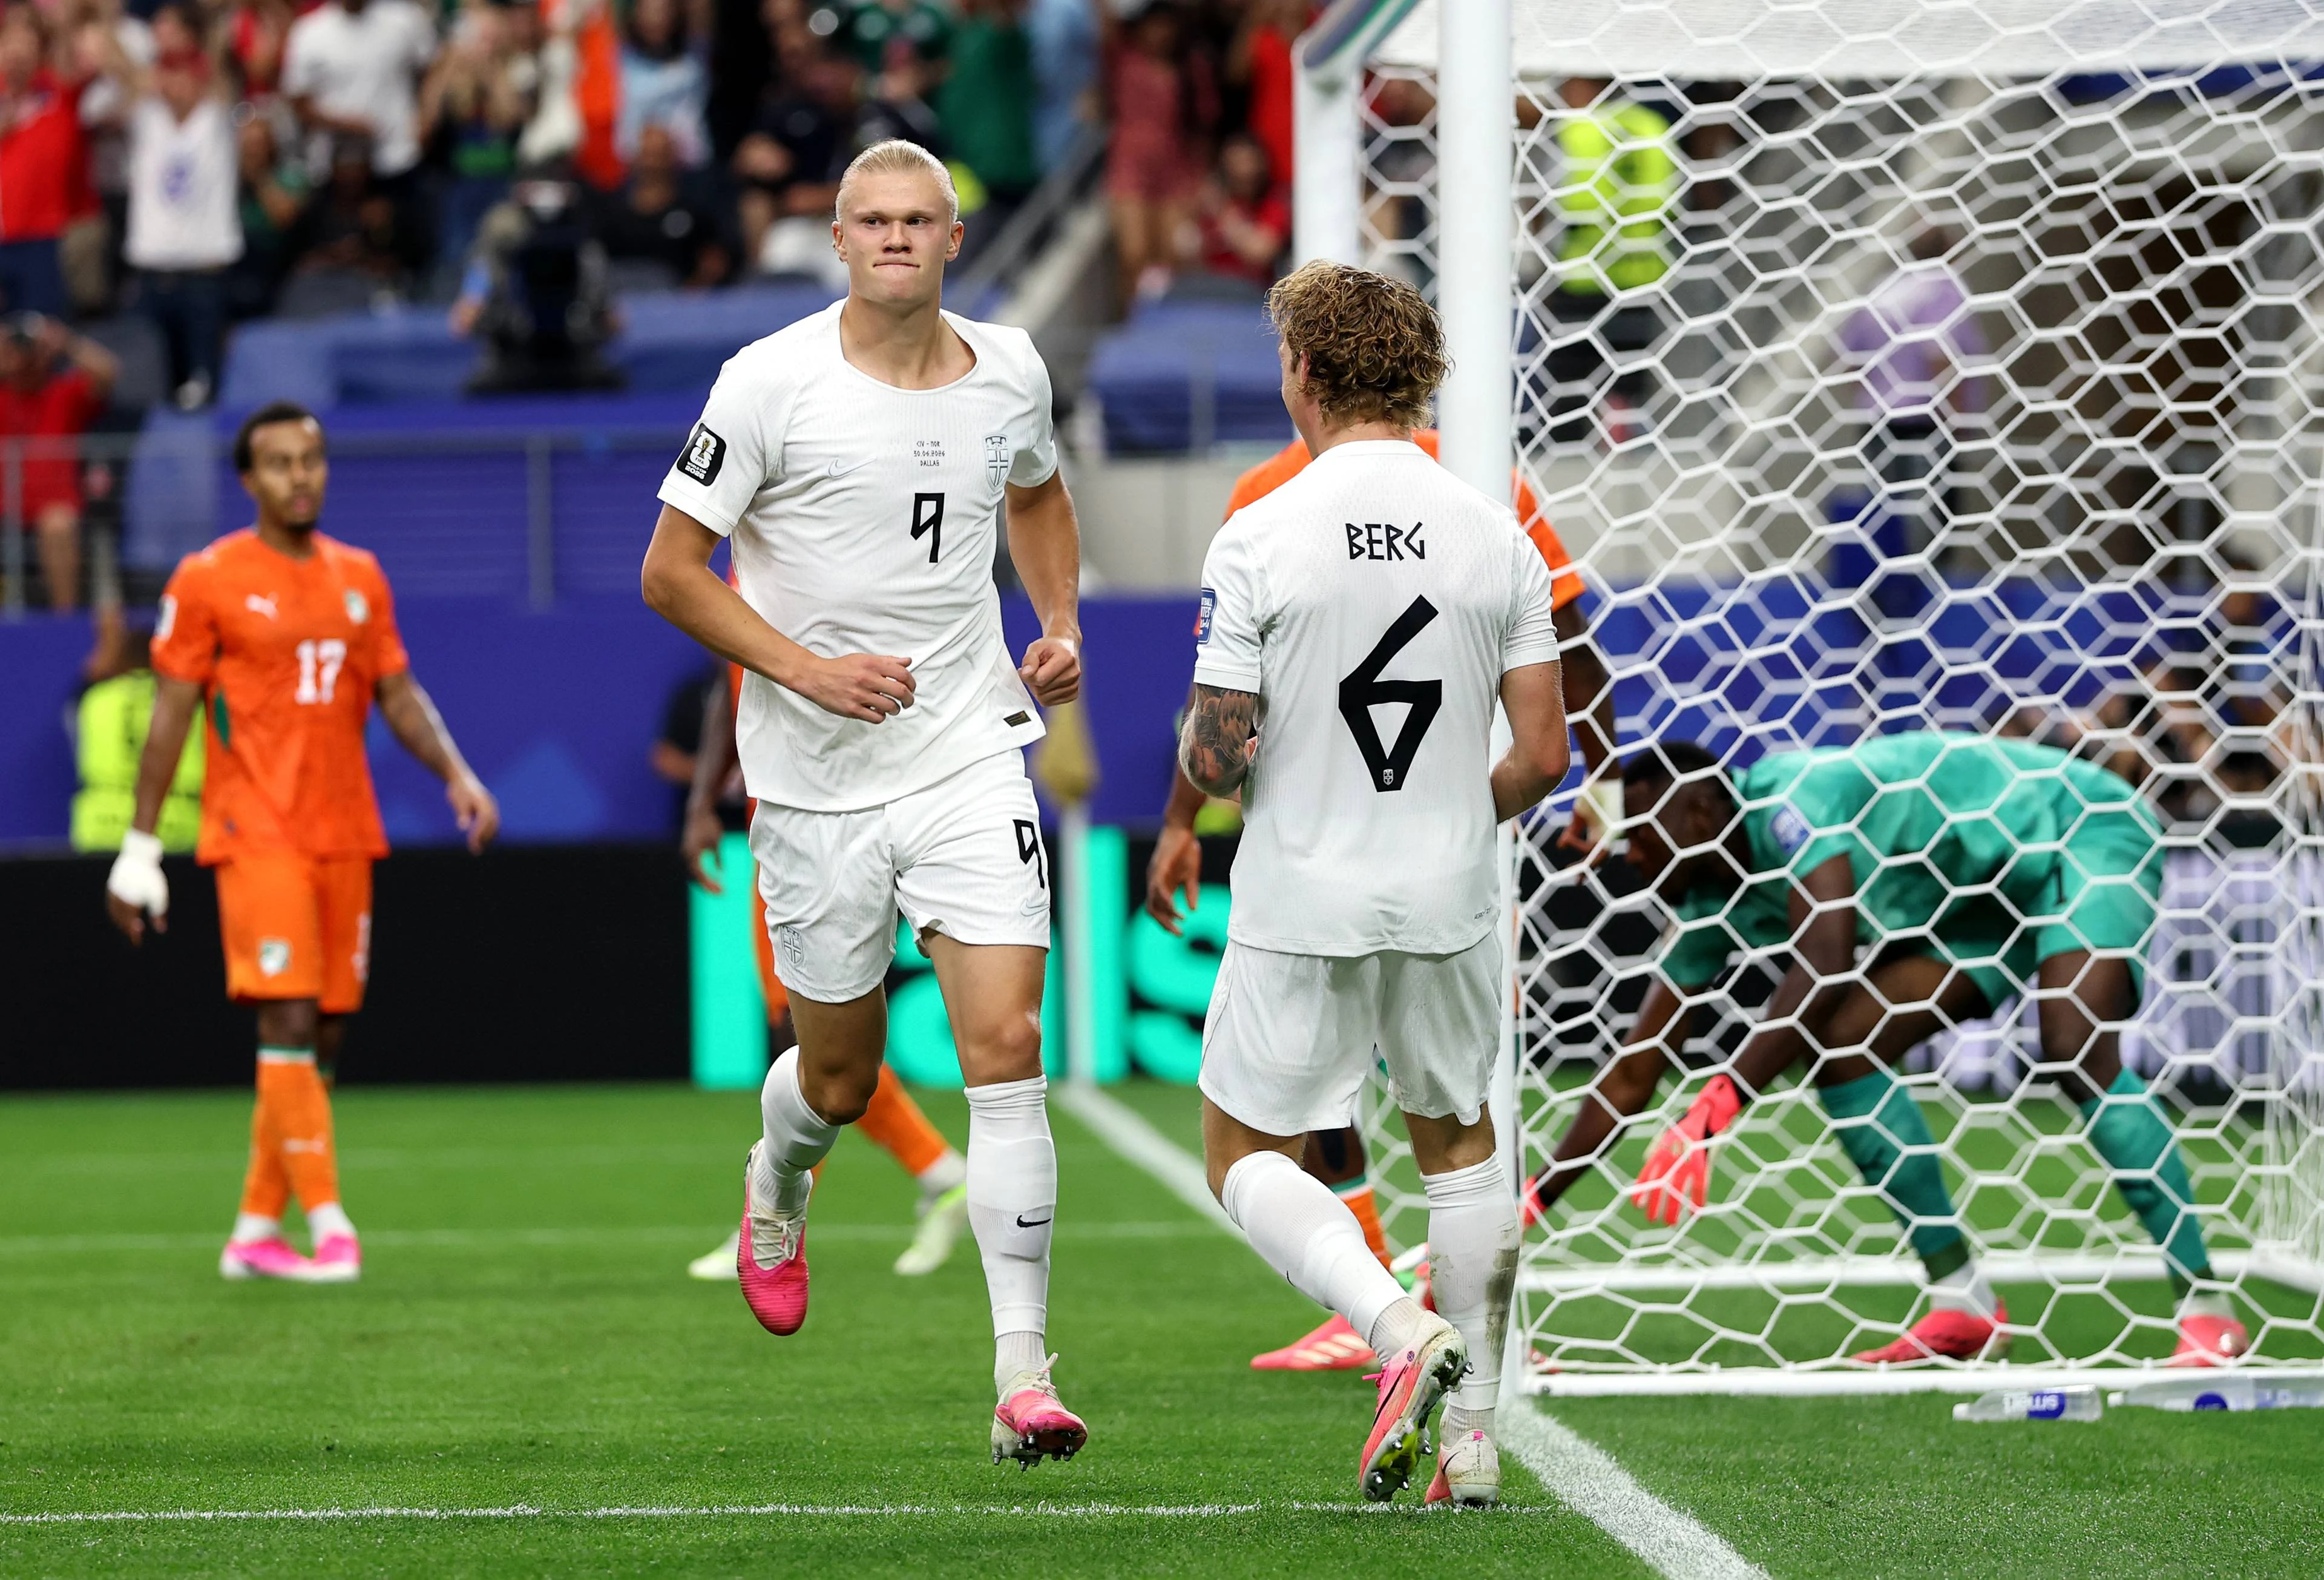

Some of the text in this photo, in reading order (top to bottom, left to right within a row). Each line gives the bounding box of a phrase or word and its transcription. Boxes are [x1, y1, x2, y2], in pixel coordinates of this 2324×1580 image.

[684, 465, 705, 479] 2026
[687, 461, 700, 470] WORLD
[910, 492, 945, 564] 9
[1345, 521, 1426, 561] BERG
[295, 639, 347, 705] 17
[1338, 594, 1443, 793] 6
[1012, 819, 1045, 889] 9
